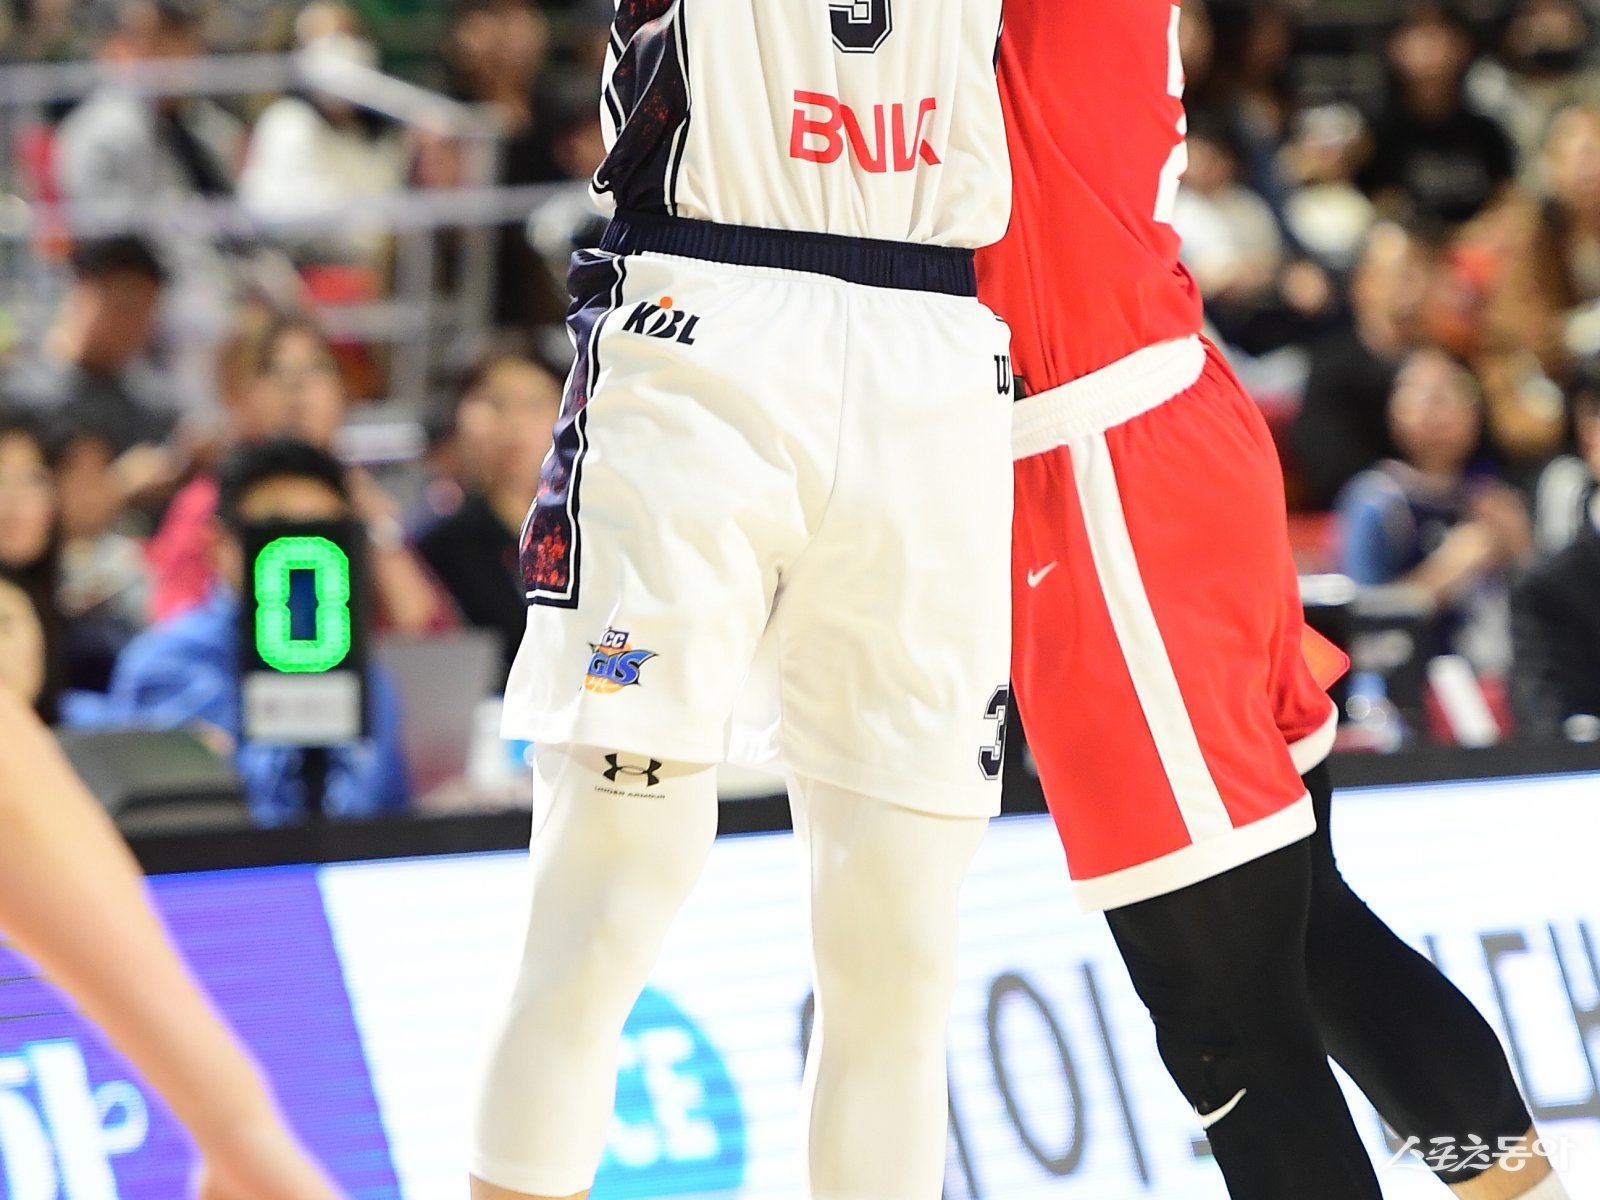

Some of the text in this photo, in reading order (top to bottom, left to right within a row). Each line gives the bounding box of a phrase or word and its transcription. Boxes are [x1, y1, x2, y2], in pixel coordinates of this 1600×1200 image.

[789, 90, 942, 174] BNK
[622, 296, 700, 346] KBL
[255, 536, 351, 673] 0
[978, 685, 1009, 781] 3
